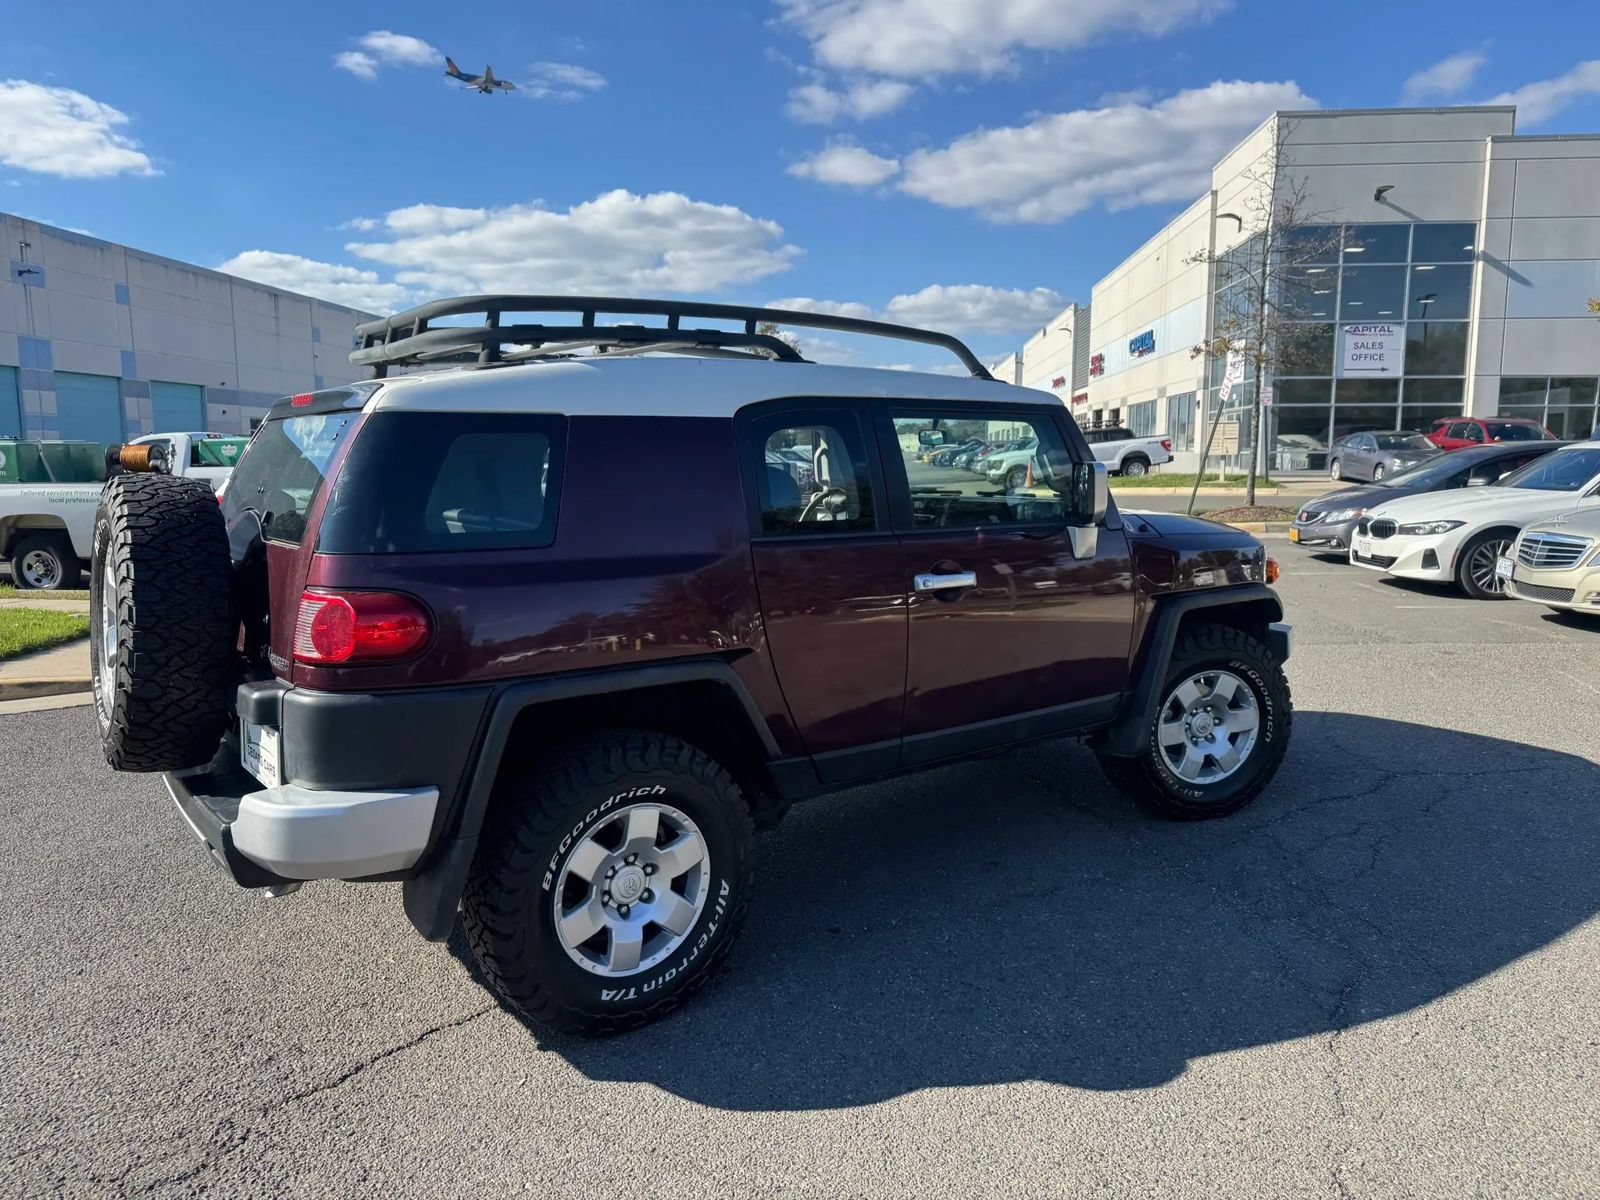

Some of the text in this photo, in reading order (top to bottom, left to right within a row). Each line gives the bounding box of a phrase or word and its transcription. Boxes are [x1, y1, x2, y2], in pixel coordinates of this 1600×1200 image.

[1351, 353, 1385, 361] OFFICE
[1353, 341, 1384, 350] SALES
[542, 784, 667, 892] BFGoodrich
[601, 878, 730, 1001] All-Terrain T/A
